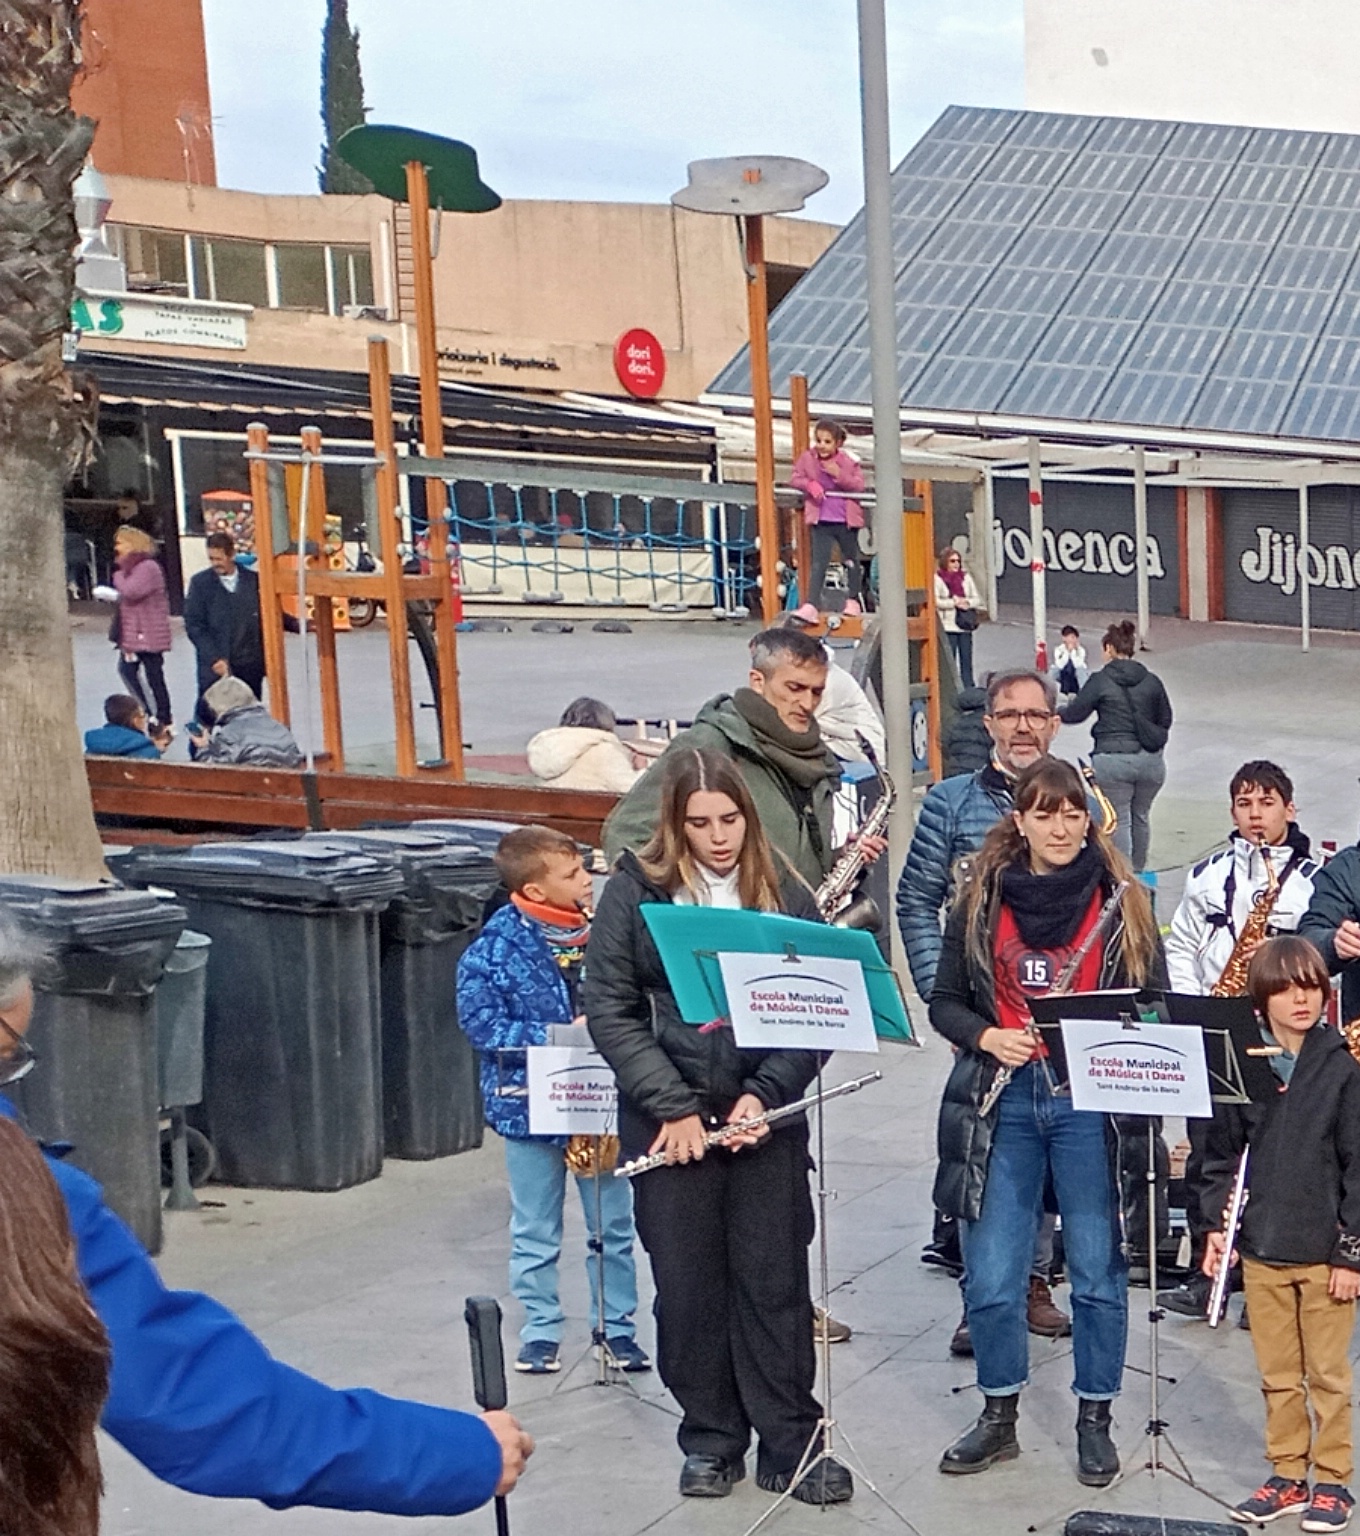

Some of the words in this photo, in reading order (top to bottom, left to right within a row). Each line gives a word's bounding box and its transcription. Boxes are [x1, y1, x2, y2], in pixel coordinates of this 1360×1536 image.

[627, 343, 651, 360] dori
[1025, 960, 1047, 981] 15
[751, 991, 786, 1001] Escola
[788, 992, 844, 1005] Municipal
[750, 1001, 764, 1012] de
[767, 1002, 807, 1014] Música
[815, 1005, 850, 1017] Dansa
[1090, 1057, 1123, 1068] Escola
[1126, 1059, 1181, 1071] Municipal
[1088, 1067, 1102, 1078] de
[1105, 1067, 1144, 1080] Música
[1152, 1071, 1186, 1082] Dansa
[552, 1081, 584, 1092] Escola
[549, 1092, 563, 1102] de
[565, 1091, 603, 1102] Música
